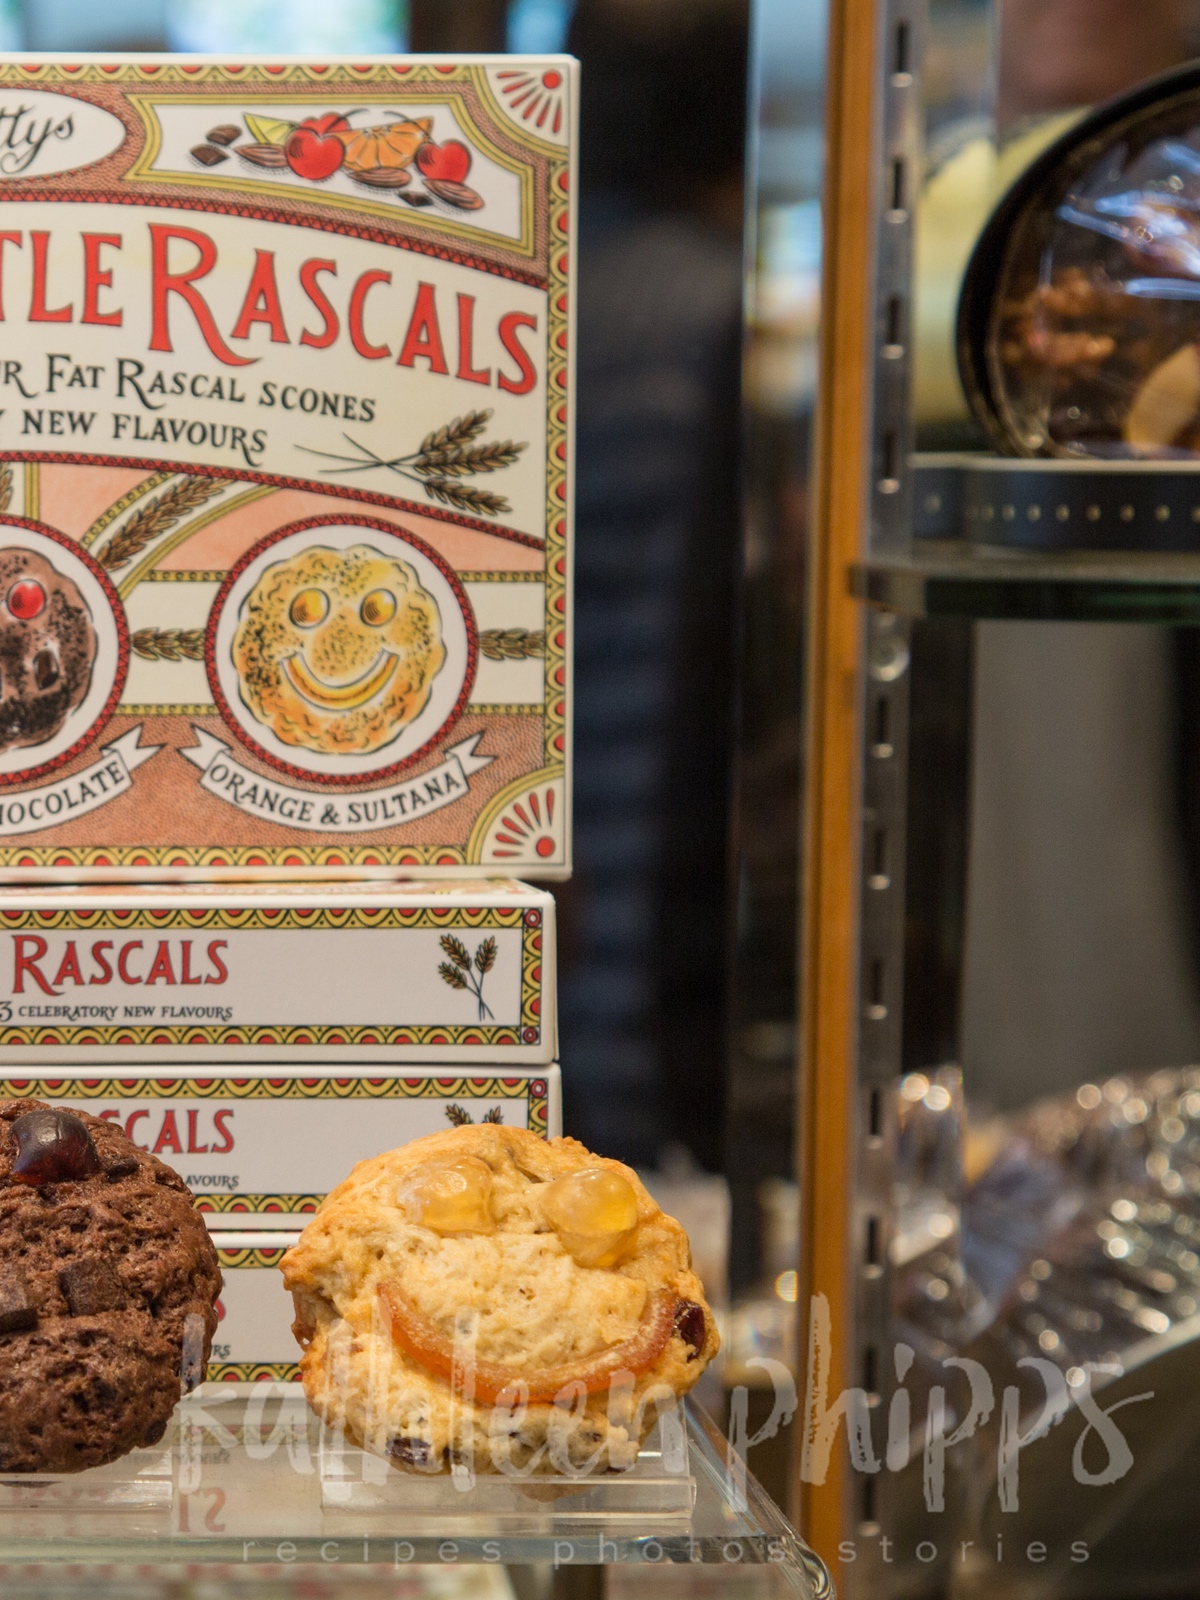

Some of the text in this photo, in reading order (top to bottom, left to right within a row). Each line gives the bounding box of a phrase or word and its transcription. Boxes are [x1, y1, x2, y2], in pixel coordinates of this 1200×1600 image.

[147, 222, 539, 396] RASCALS
[259, 382, 377, 423] SCONES
[21, 410, 98, 437] NEW
[112, 413, 269, 468] FLAVOURS
[208, 764, 462, 825] ORANGE & SULTANA
[11, 934, 229, 997] RASCALS
[18, 1005, 119, 1021] CELEBRATORY
[123, 1005, 156, 1018] NEW
[161, 1006, 233, 1022] FLAVOURS
[184, 1174, 240, 1191] AVOURS
